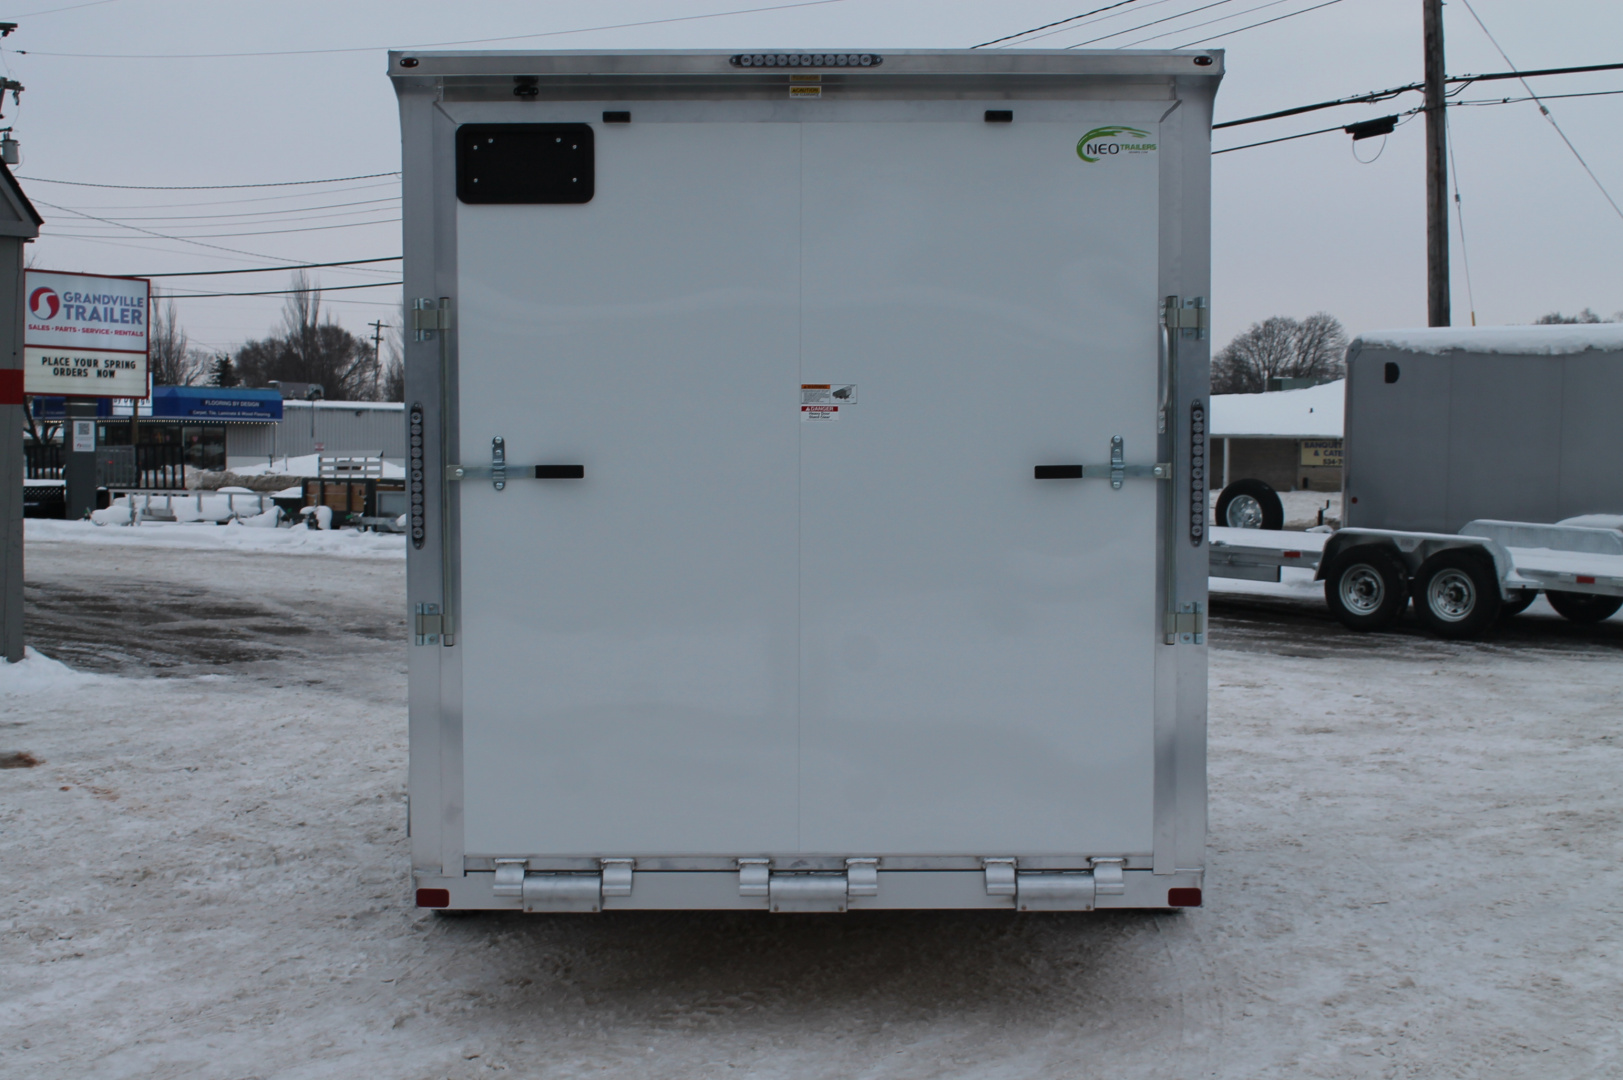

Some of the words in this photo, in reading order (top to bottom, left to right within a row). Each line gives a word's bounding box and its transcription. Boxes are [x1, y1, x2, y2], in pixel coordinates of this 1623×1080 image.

[1087, 143, 1119, 155] NEO
[63, 291, 144, 307] GRANDVILLE
[63, 305, 143, 325] TRAILER
[42, 356, 70, 366] PLACE
[74, 358, 98, 367] YOUR
[104, 359, 136, 369] SPRING
[53, 367, 88, 377] ORDERS
[97, 369, 116, 378] NOW
